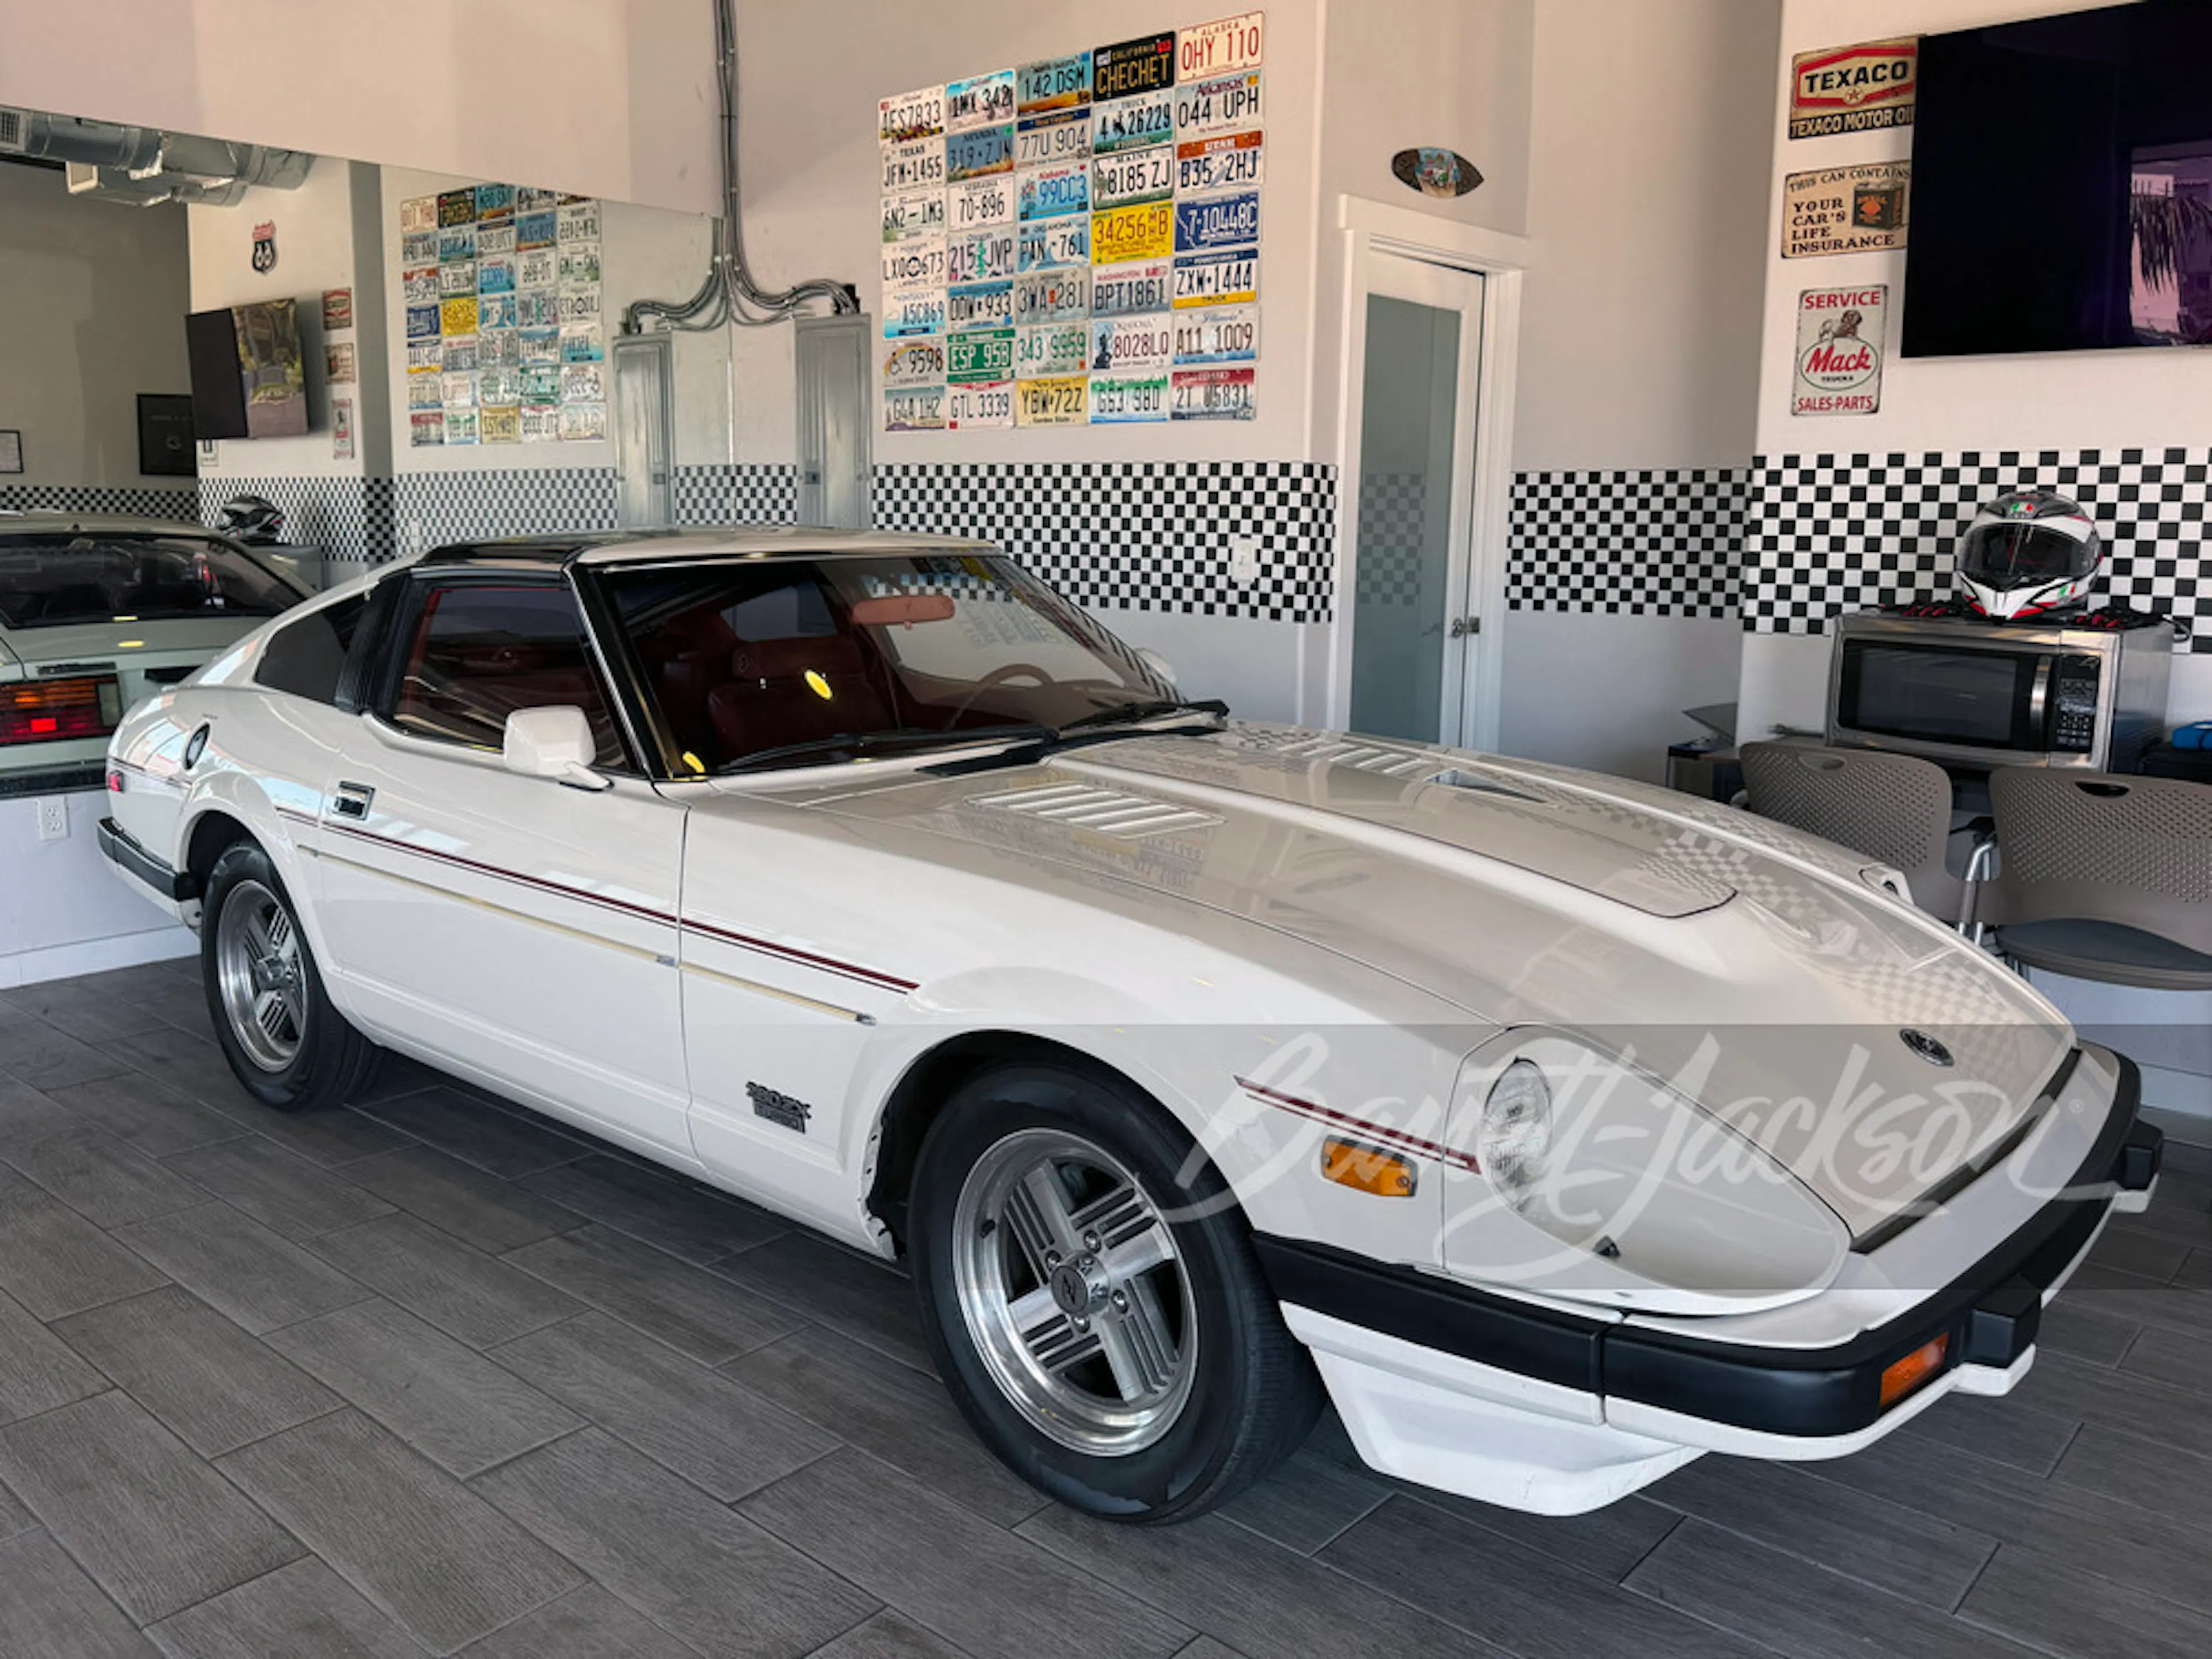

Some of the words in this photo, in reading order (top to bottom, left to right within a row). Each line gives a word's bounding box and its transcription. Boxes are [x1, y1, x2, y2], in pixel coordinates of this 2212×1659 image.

[1228, 26, 1259, 61] 110
[1025, 74, 1051, 101] 142
[1805, 61, 1908, 93] TEXACO
[1224, 87, 1258, 119] UPH
[1791, 115, 1842, 138] TEXACO
[1844, 108, 1893, 131] MOTOR
[1056, 124, 1086, 151] 904
[1108, 162, 1146, 195] 8185
[1181, 157, 1211, 188] B35
[1226, 150, 1257, 181] 2HJ
[1789, 177, 1816, 192] THIS
[1821, 172, 1844, 184] CAN
[1792, 211, 1845, 226] CAR'S
[1793, 198, 1843, 213] YOUR
[1791, 234, 1894, 254] INSURANCE
[1792, 226, 1831, 241] LIFE
[951, 243, 975, 272] 215
[1805, 290, 1880, 309] SERVICE
[1806, 345, 1871, 373] Mack
[1798, 395, 1873, 412] SALES-PARTS
